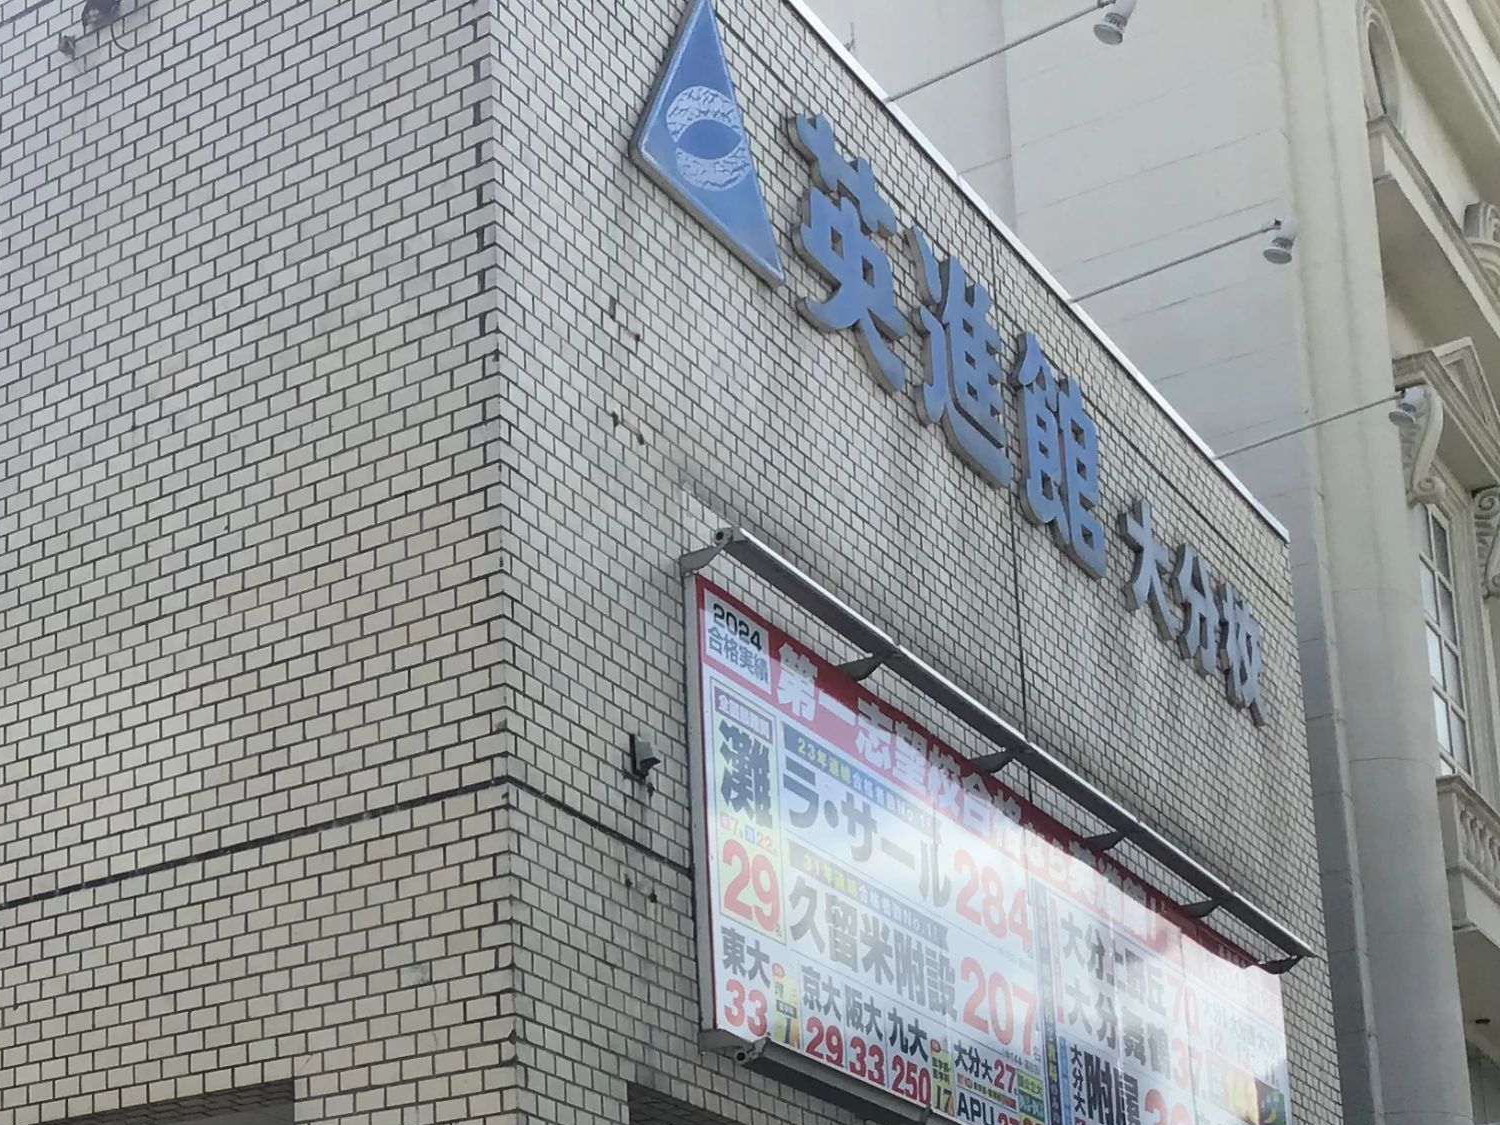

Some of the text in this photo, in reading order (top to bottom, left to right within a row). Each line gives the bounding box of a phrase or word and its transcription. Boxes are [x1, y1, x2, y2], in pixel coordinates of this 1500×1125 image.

[786, 111, 1267, 727] 英進館 大分校
[707, 626, 769, 685] 合格実績
[713, 603, 763, 650] 2024
[719, 719, 772, 829] 灘
[783, 757, 1032, 944] ラ・サール 284
[721, 838, 781, 932] 29
[721, 925, 771, 988] 東大
[789, 878, 958, 1021] 久留米附設
[960, 956, 1036, 1055] 207
[724, 979, 768, 1037] 33
[802, 964, 842, 1021] 京大
[845, 984, 884, 1042] 阪大
[806, 1016, 844, 1068] 29
[849, 1036, 885, 1086] 33
[888, 1008, 929, 1062] 九大
[892, 1055, 931, 1105] 250
[954, 1040, 993, 1083] 大分大
[994, 1059, 1016, 1093] 27
[1070, 1044, 1086, 1116] 大分大
